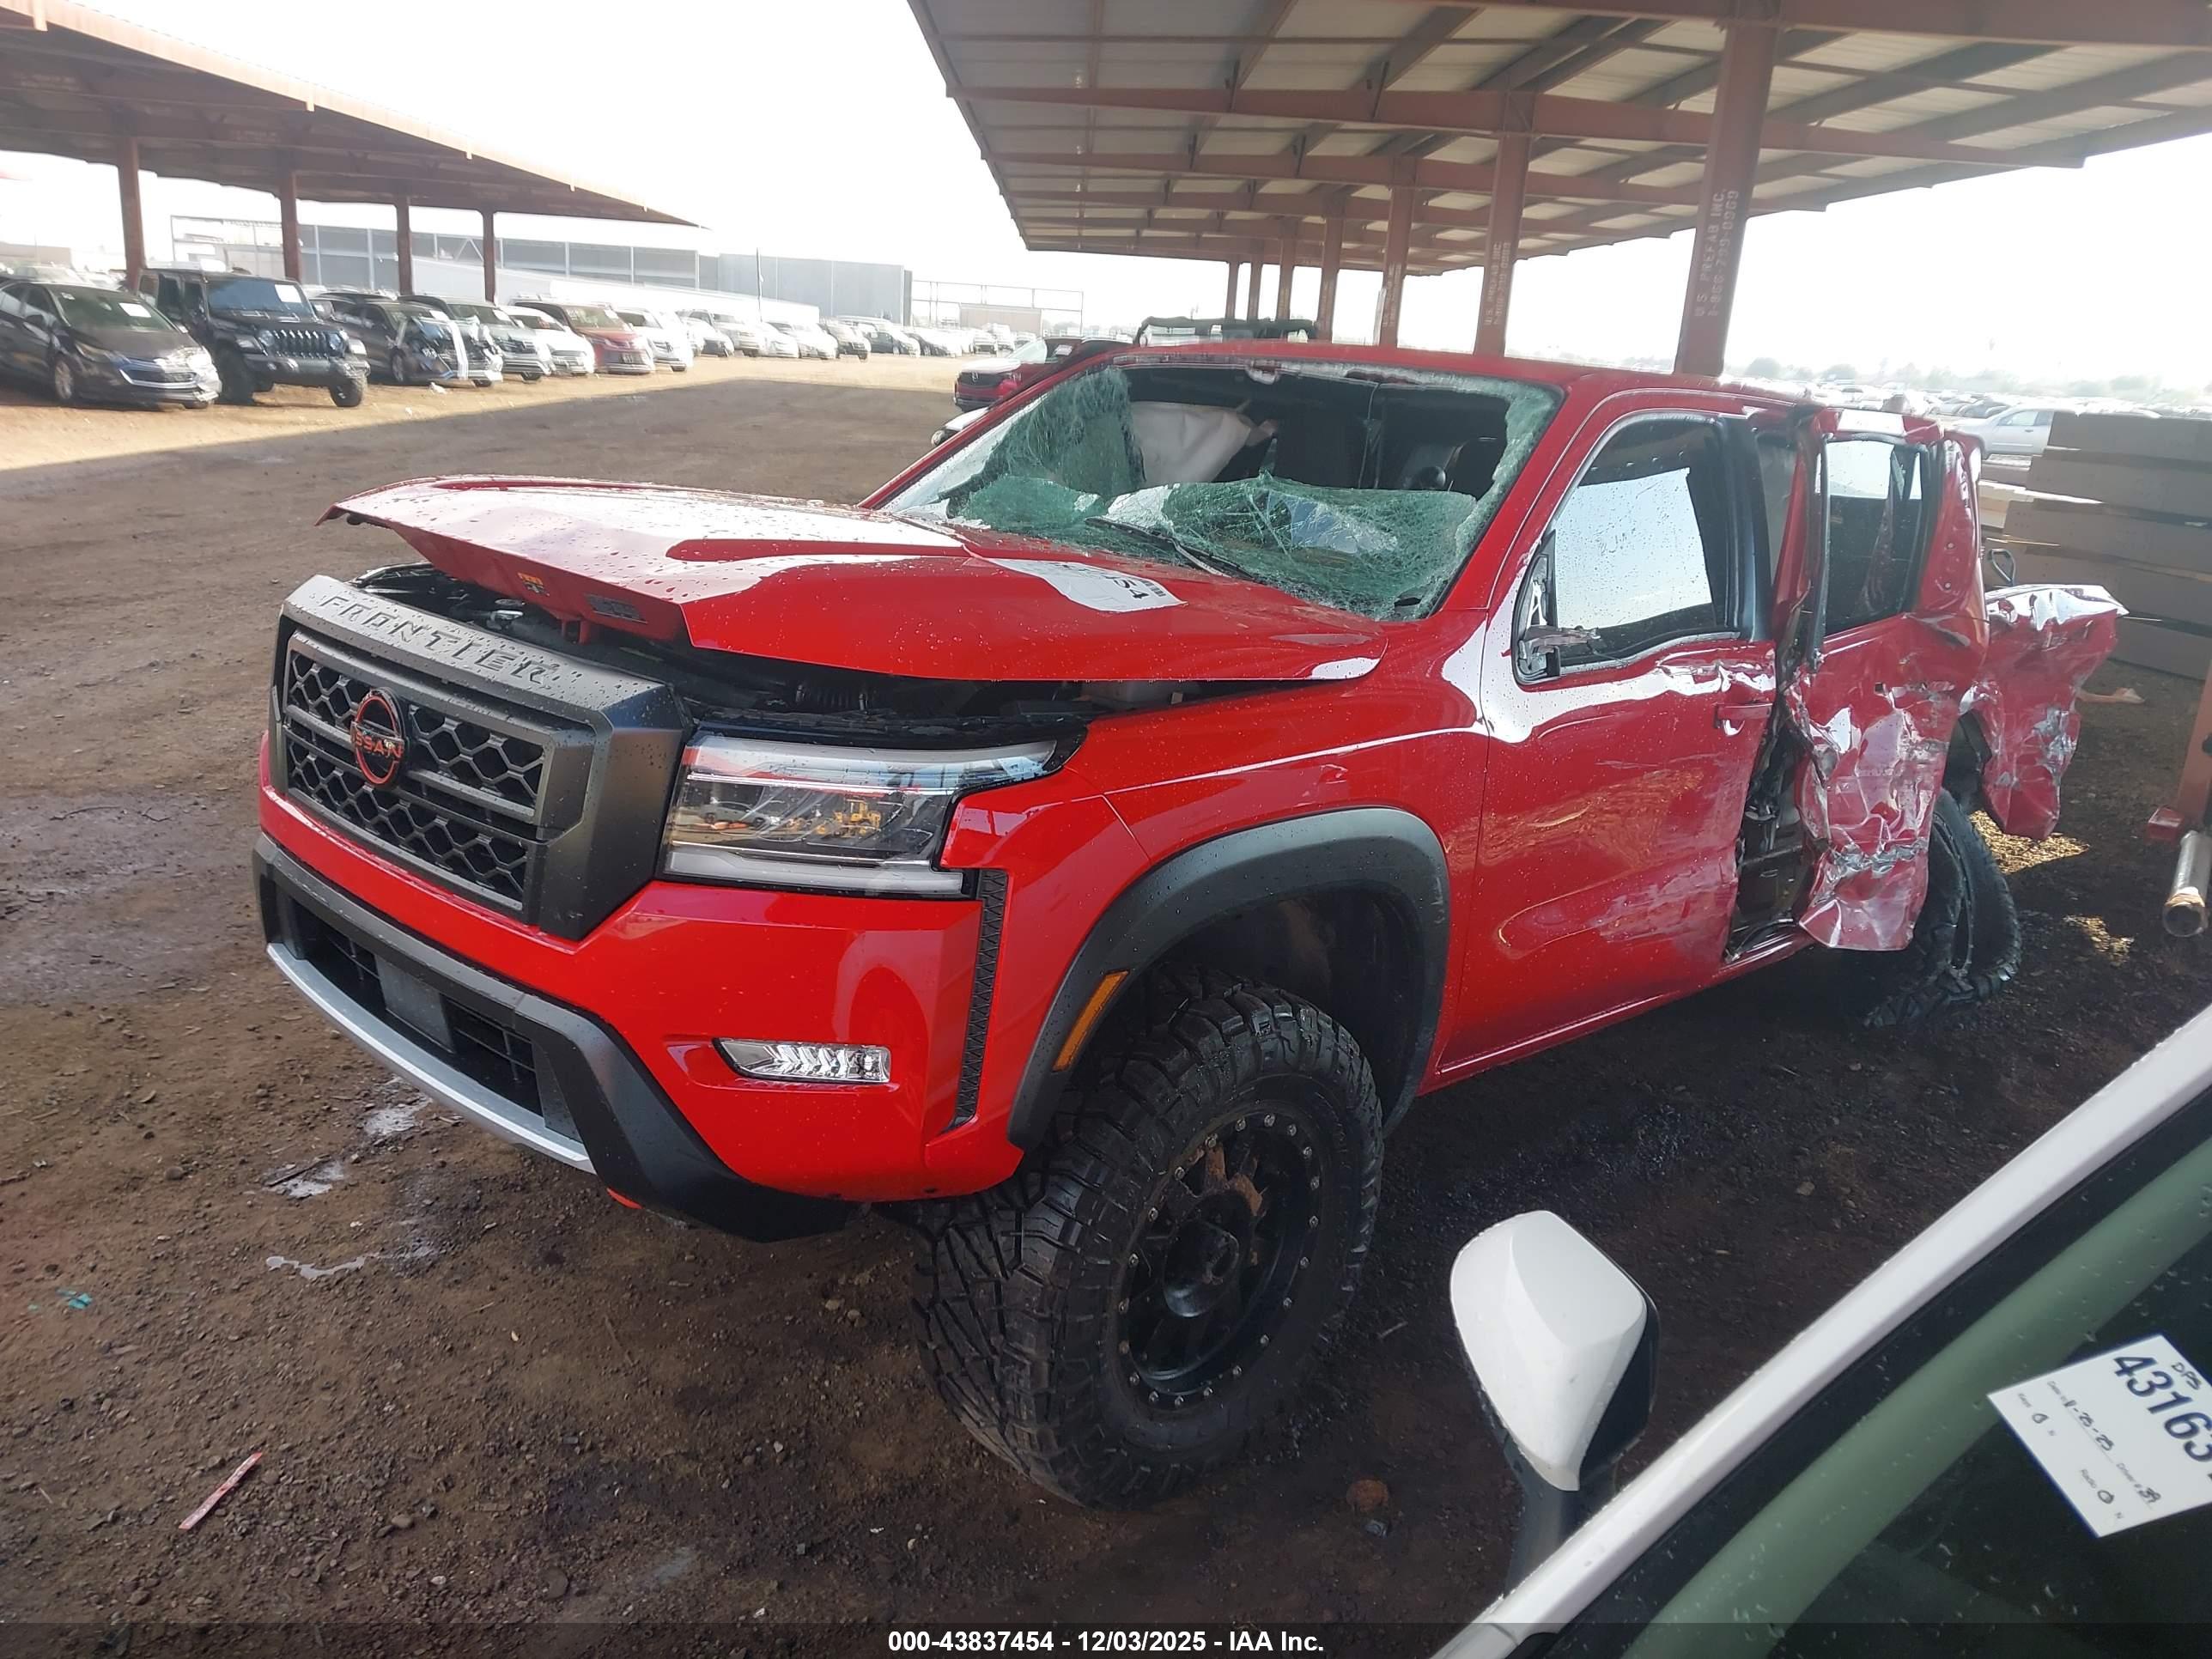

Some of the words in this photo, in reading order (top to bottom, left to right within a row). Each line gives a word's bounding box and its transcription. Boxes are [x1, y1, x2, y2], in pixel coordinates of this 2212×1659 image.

[1700, 224, 1719, 282] PREFAB
[319, 595, 556, 685] FRONTIER
[2113, 1357, 2212, 1481] 43163
